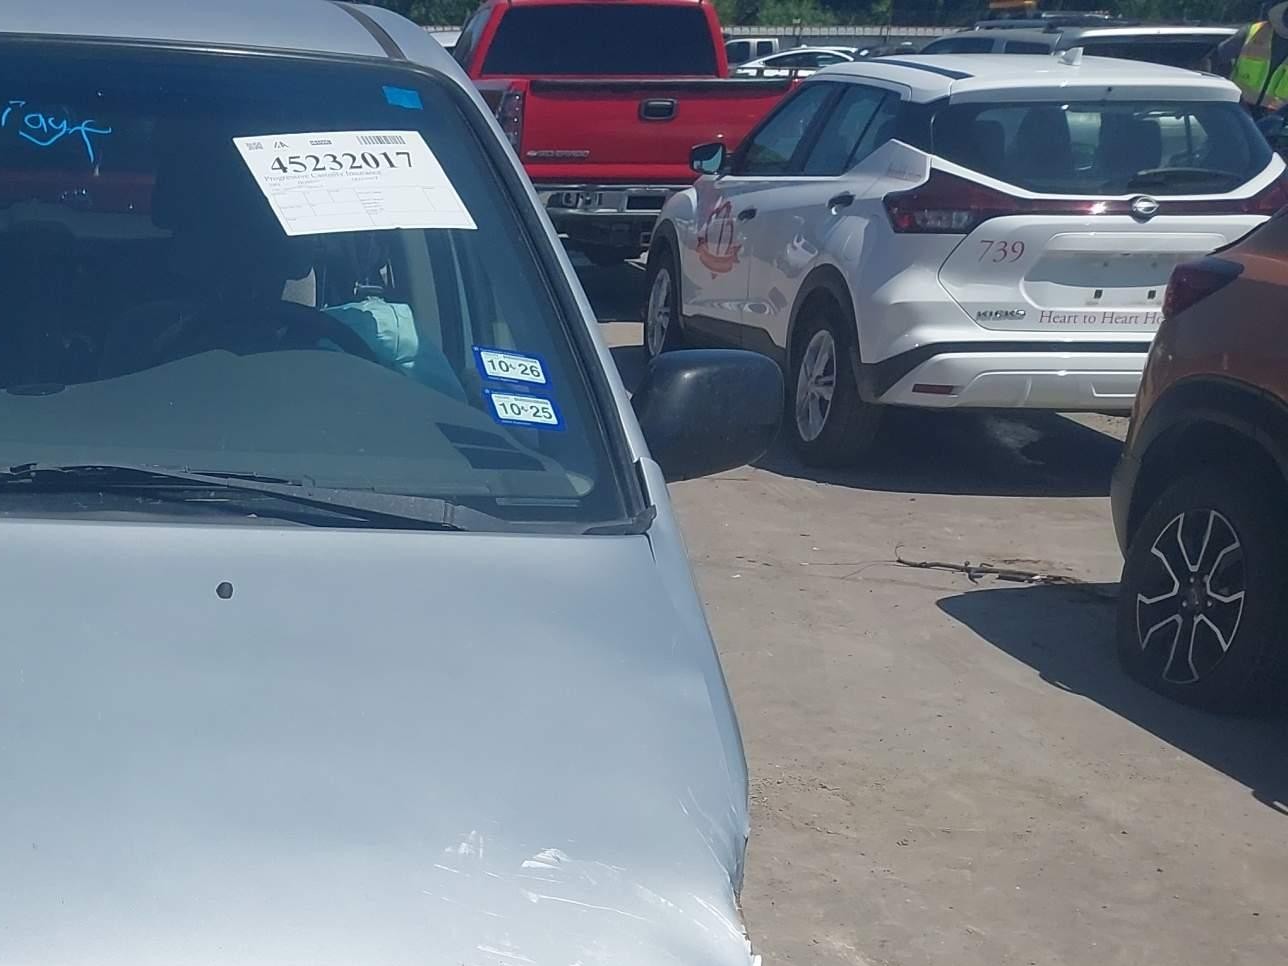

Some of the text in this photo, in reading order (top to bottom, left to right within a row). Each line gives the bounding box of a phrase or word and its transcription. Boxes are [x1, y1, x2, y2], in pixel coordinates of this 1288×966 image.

[271, 151, 413, 174] 45232017
[978, 239, 1025, 263] 739
[1039, 311, 1077, 324] Heart
[1083, 312, 1096, 324] to
[1101, 311, 1139, 324] Heart
[518, 363, 541, 378] 26
[529, 405, 553, 420] 25
